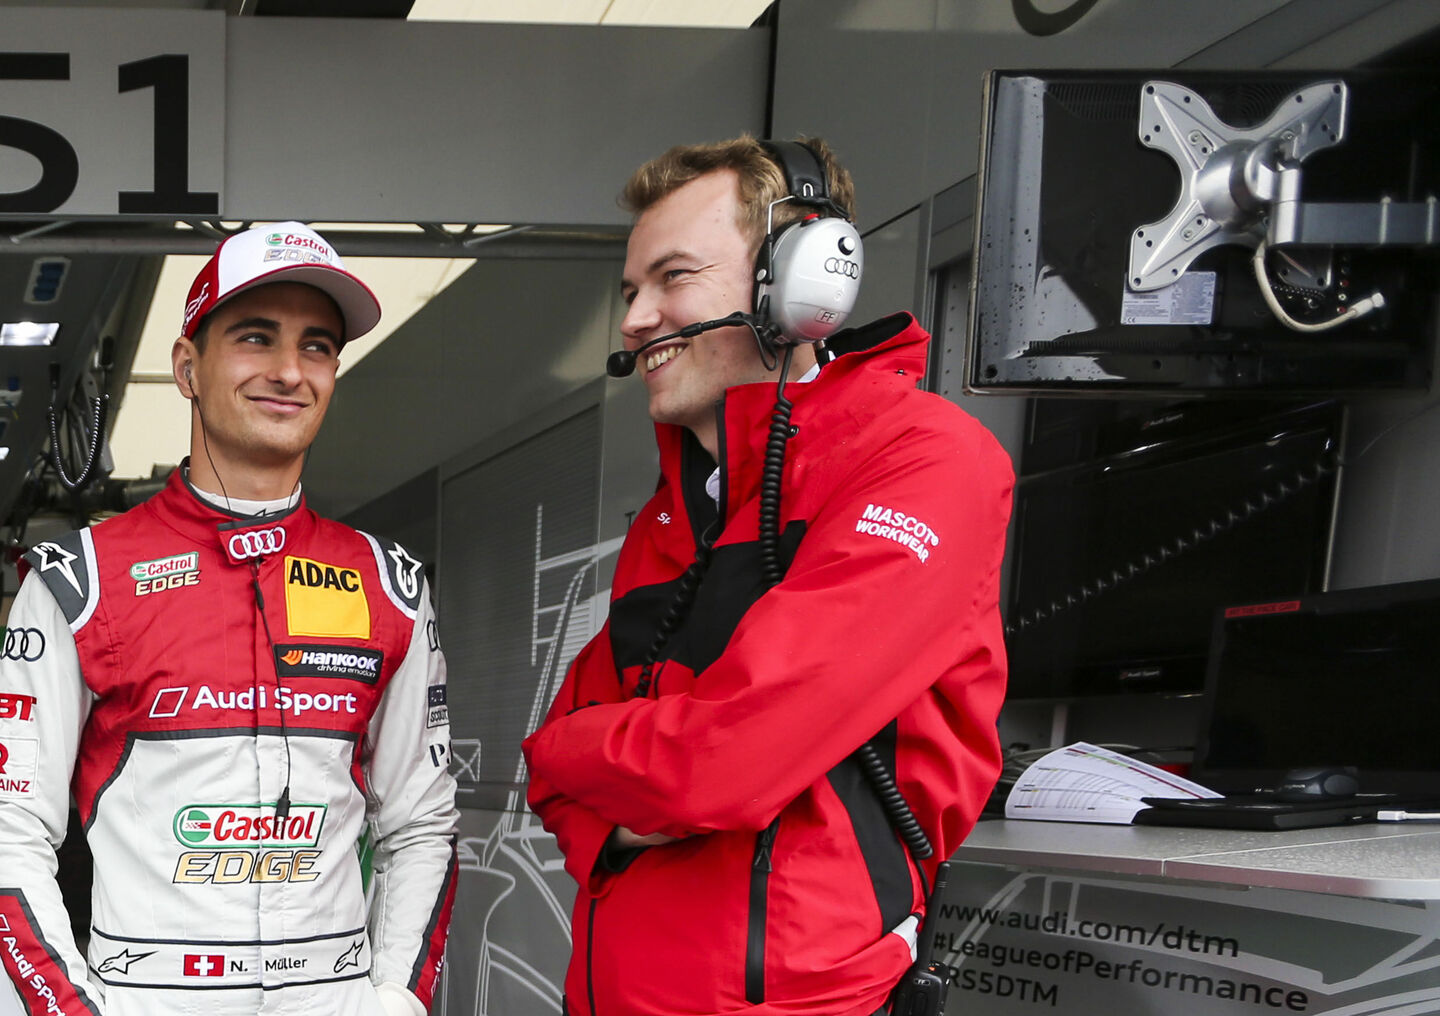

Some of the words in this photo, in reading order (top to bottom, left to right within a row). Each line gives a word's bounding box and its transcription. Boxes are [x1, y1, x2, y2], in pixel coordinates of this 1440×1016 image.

[263, 248, 331, 266] EDG
[284, 234, 329, 256] Castrol
[820, 311, 836, 322] FF
[855, 519, 929, 563] WORKWEAR
[147, 556, 192, 576] Castrol
[288, 559, 360, 593] ADAC
[135, 570, 202, 596] EDGE
[316, 664, 347, 674] driving
[347, 667, 376, 678] emotion
[191, 685, 267, 711] Audi
[273, 686, 357, 716] Sport
[172, 850, 323, 885] EDGE
[938, 903, 1240, 959] www.audi.com/dtm
[3, 936, 36, 979] Audi
[230, 960, 249, 972] N.
[265, 957, 308, 972] Müller
[932, 930, 1310, 1013] #LeagueofPerformance
